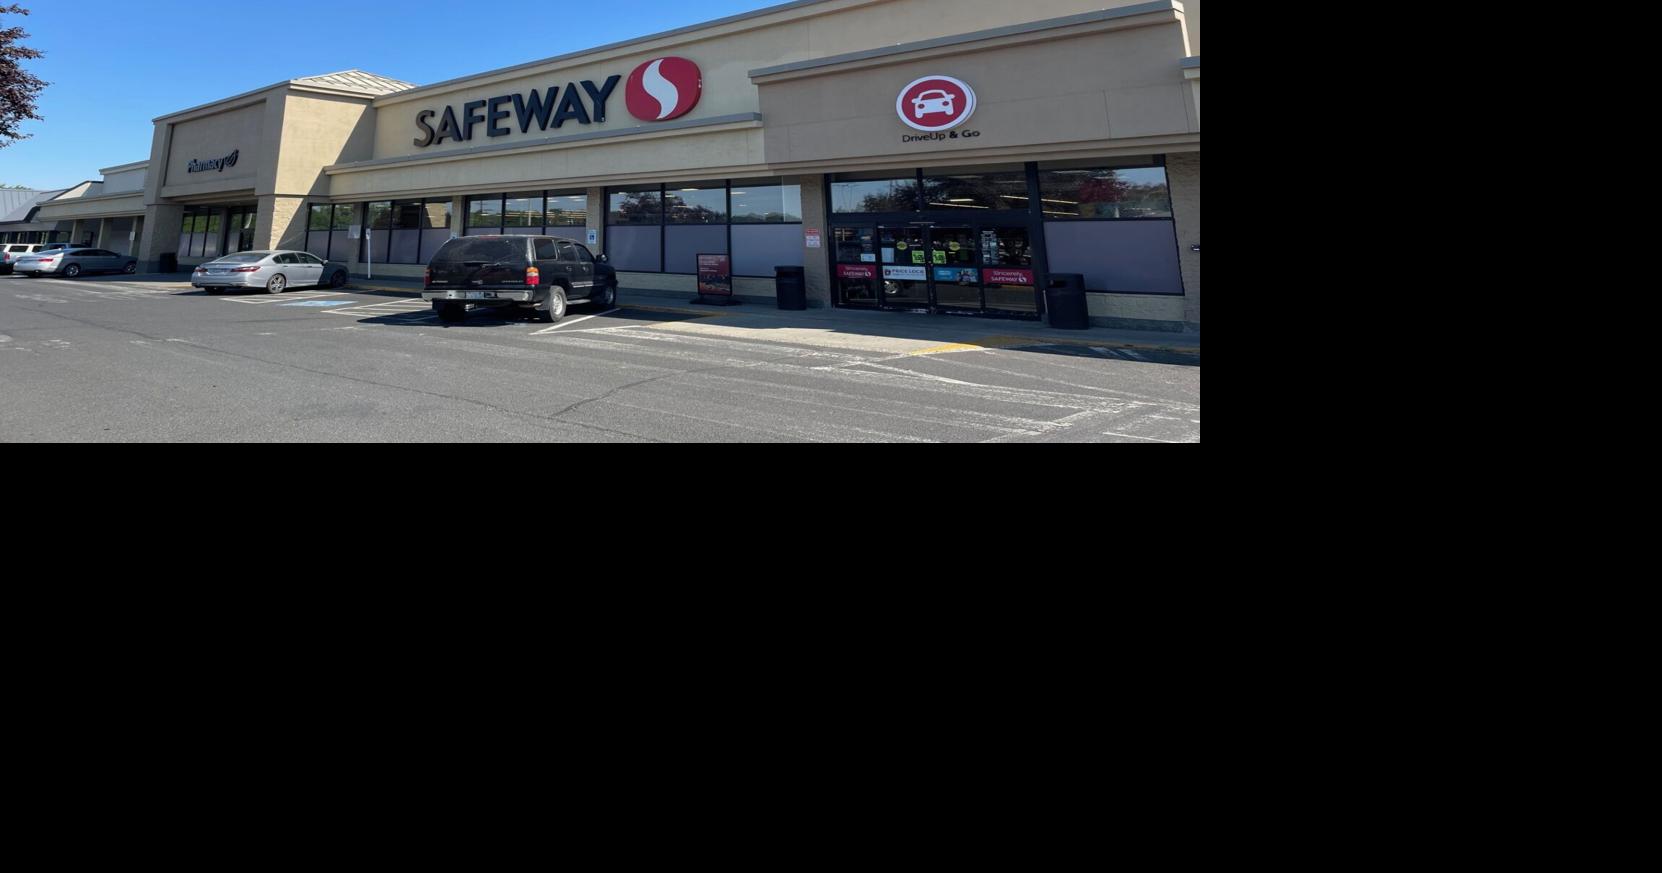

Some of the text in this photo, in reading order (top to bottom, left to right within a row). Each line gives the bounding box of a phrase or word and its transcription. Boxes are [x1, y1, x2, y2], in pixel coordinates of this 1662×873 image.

[413, 74, 622, 147] SAFEWAY
[902, 129, 981, 142] DriveUp & Go
[187, 157, 225, 173] Pharmacy
